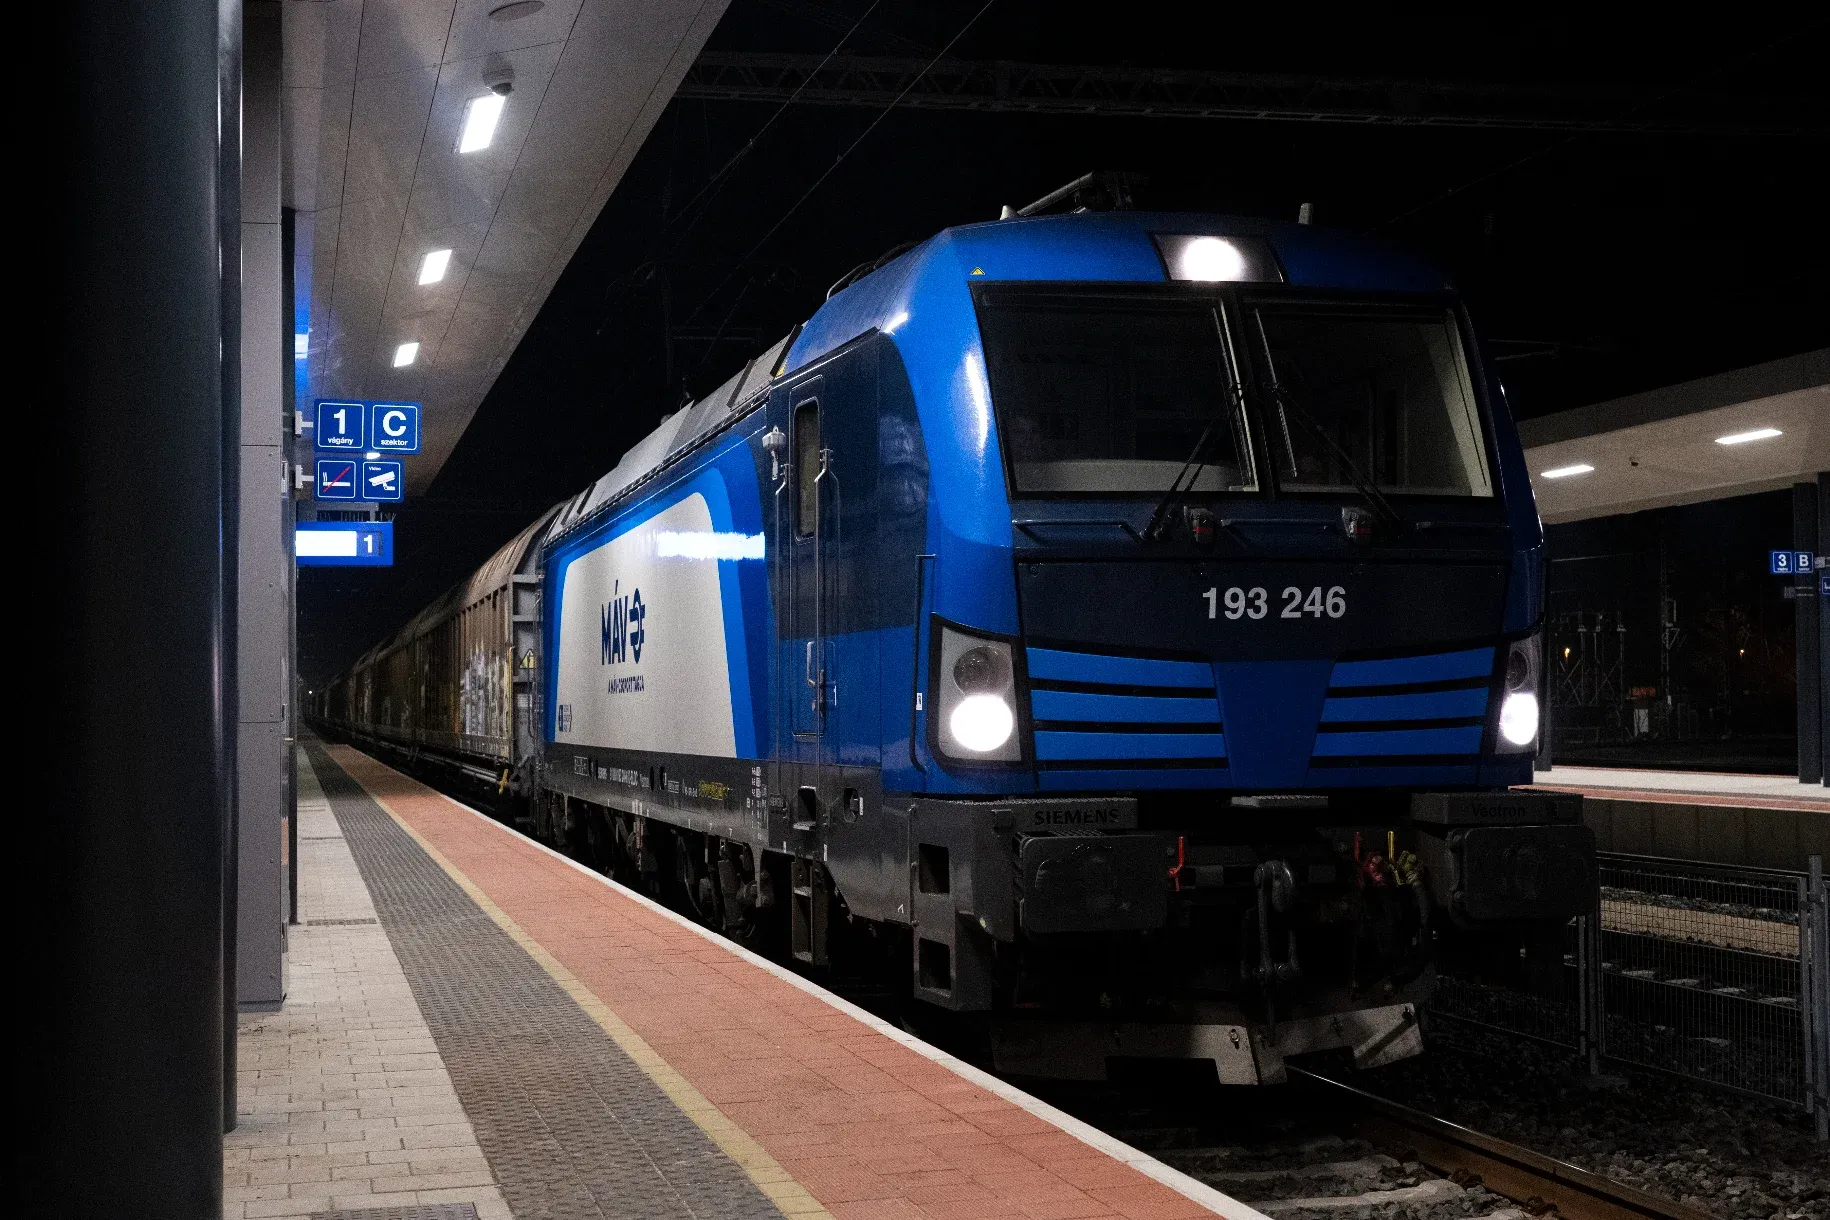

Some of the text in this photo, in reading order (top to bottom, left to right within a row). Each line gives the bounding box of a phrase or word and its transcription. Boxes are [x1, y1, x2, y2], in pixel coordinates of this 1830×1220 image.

[334, 409, 346, 434] 1
[382, 411, 407, 436] C
[328, 437, 354, 446] vágány
[381, 438, 408, 446] szektor
[363, 534, 373, 553] 1
[1778, 554, 1787, 567] 3
[1799, 554, 1809, 567] B
[1202, 586, 1346, 620] 193 246
[602, 579, 628, 665] MÁV
[1035, 809, 1119, 825] SIEMENS
